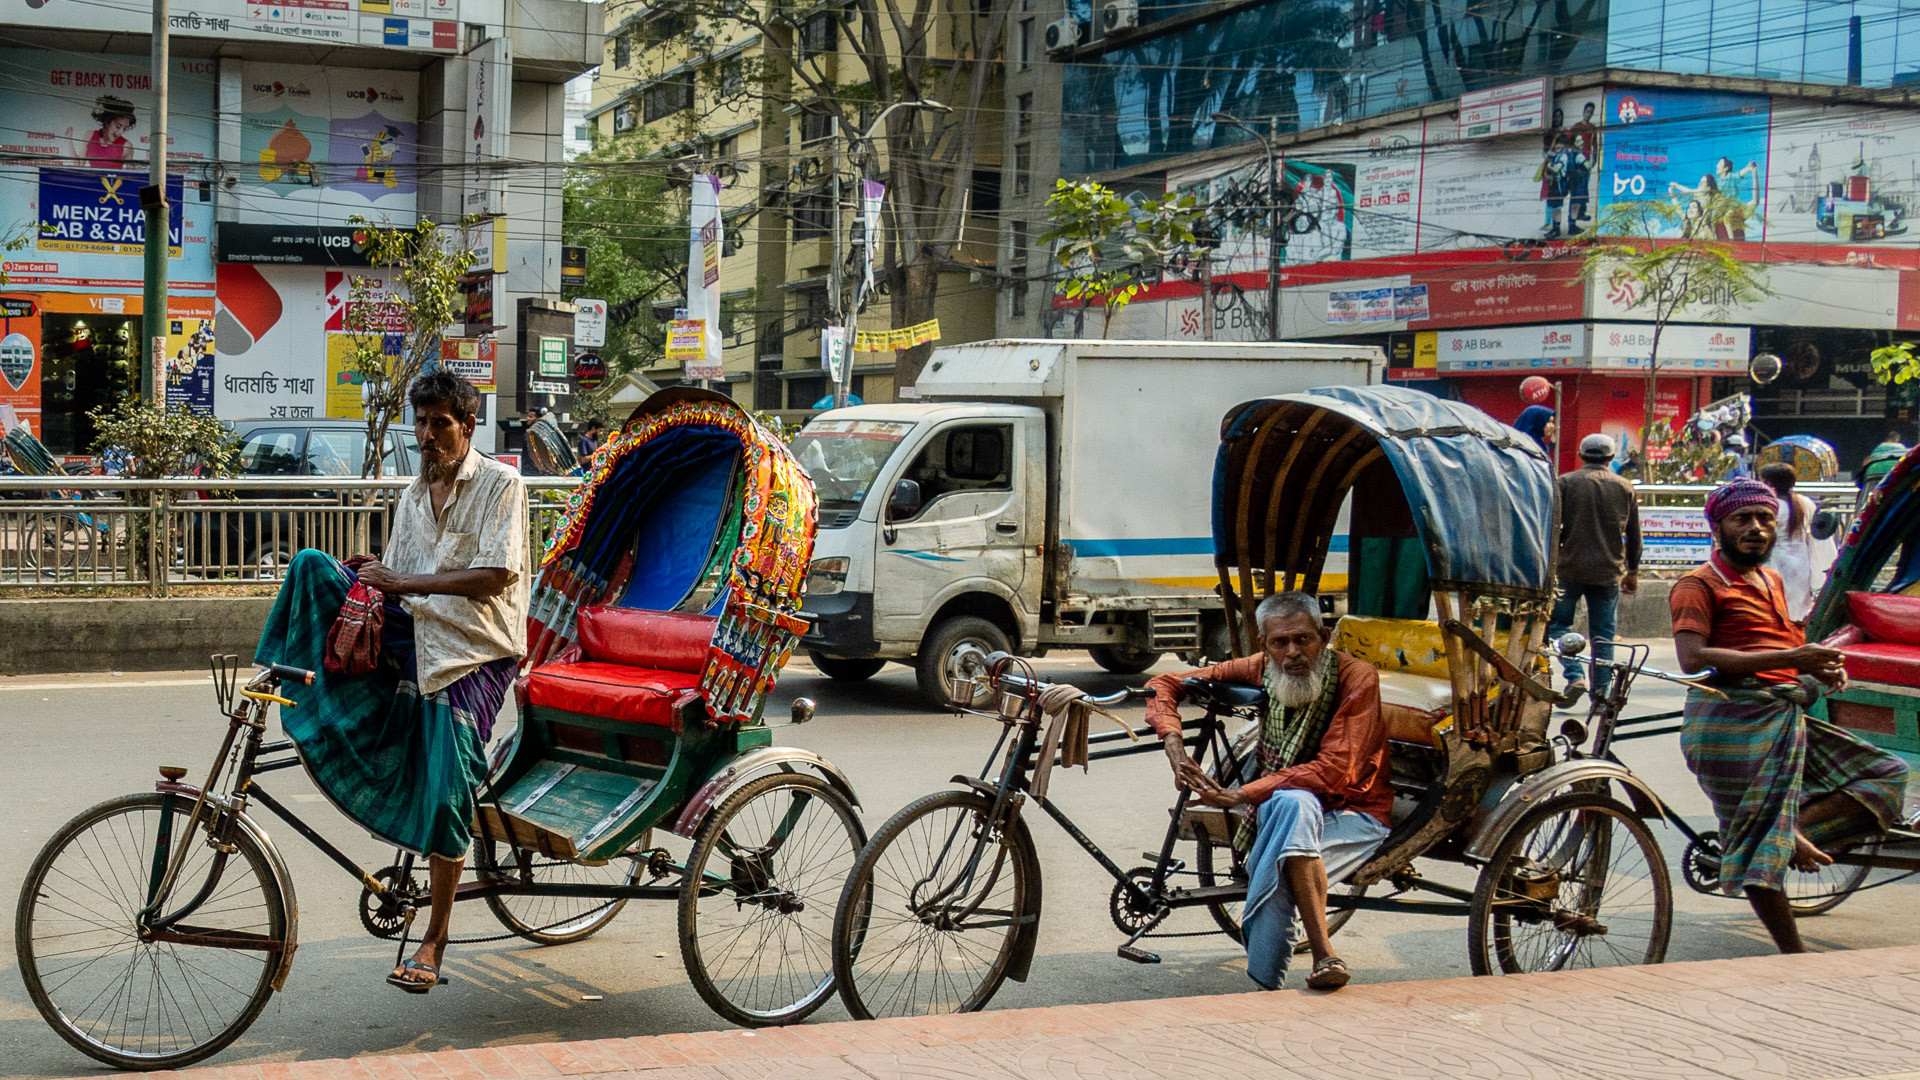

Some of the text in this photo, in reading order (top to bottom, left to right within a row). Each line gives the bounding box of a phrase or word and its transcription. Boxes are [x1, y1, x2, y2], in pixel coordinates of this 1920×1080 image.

[168, 11, 229, 31] নমন্ডি শাখা
[181, 62, 215, 74] VLCC
[51, 70, 152, 90] GET BACK TO SHA
[253, 84, 272, 93] UCB
[347, 91, 365, 99] UCB
[1613, 172, 1646, 196] ৮০
[53, 204, 146, 223] MENZ HA
[89, 224, 105, 240] &
[108, 225, 179, 244] SALN
[184, 236, 207, 244] TENANCE
[43, 242, 59, 250] Cell
[66, 242, 115, 252] 01779-66094
[323, 235, 351, 248] UCB
[14, 263, 29, 271] Zero
[30, 264, 44, 272] Cost
[45, 264, 57, 272] EMI
[1450, 274, 1537, 292] এবি ব্যাংক লিমিটেড
[1215, 309, 1226, 329] B
[1542, 332, 1571, 344] এটিএম
[1622, 335, 1660, 346] AB Ban
[1708, 332, 1735, 345] এটিএম
[1464, 339, 1503, 350] AB Bank
[545, 352, 563, 362] GREEN
[444, 360, 492, 369] Prostho
[542, 363, 565, 373] SUMMIT
[1835, 364, 1872, 373] MUS
[575, 365, 604, 379] Skyline
[224, 371, 279, 394] ধানমন্ডি
[283, 378, 314, 394] শাখা
[1532, 386, 1548, 399] ATM
[290, 406, 314, 418] তলা
[1670, 519, 1705, 529] শিখুন
